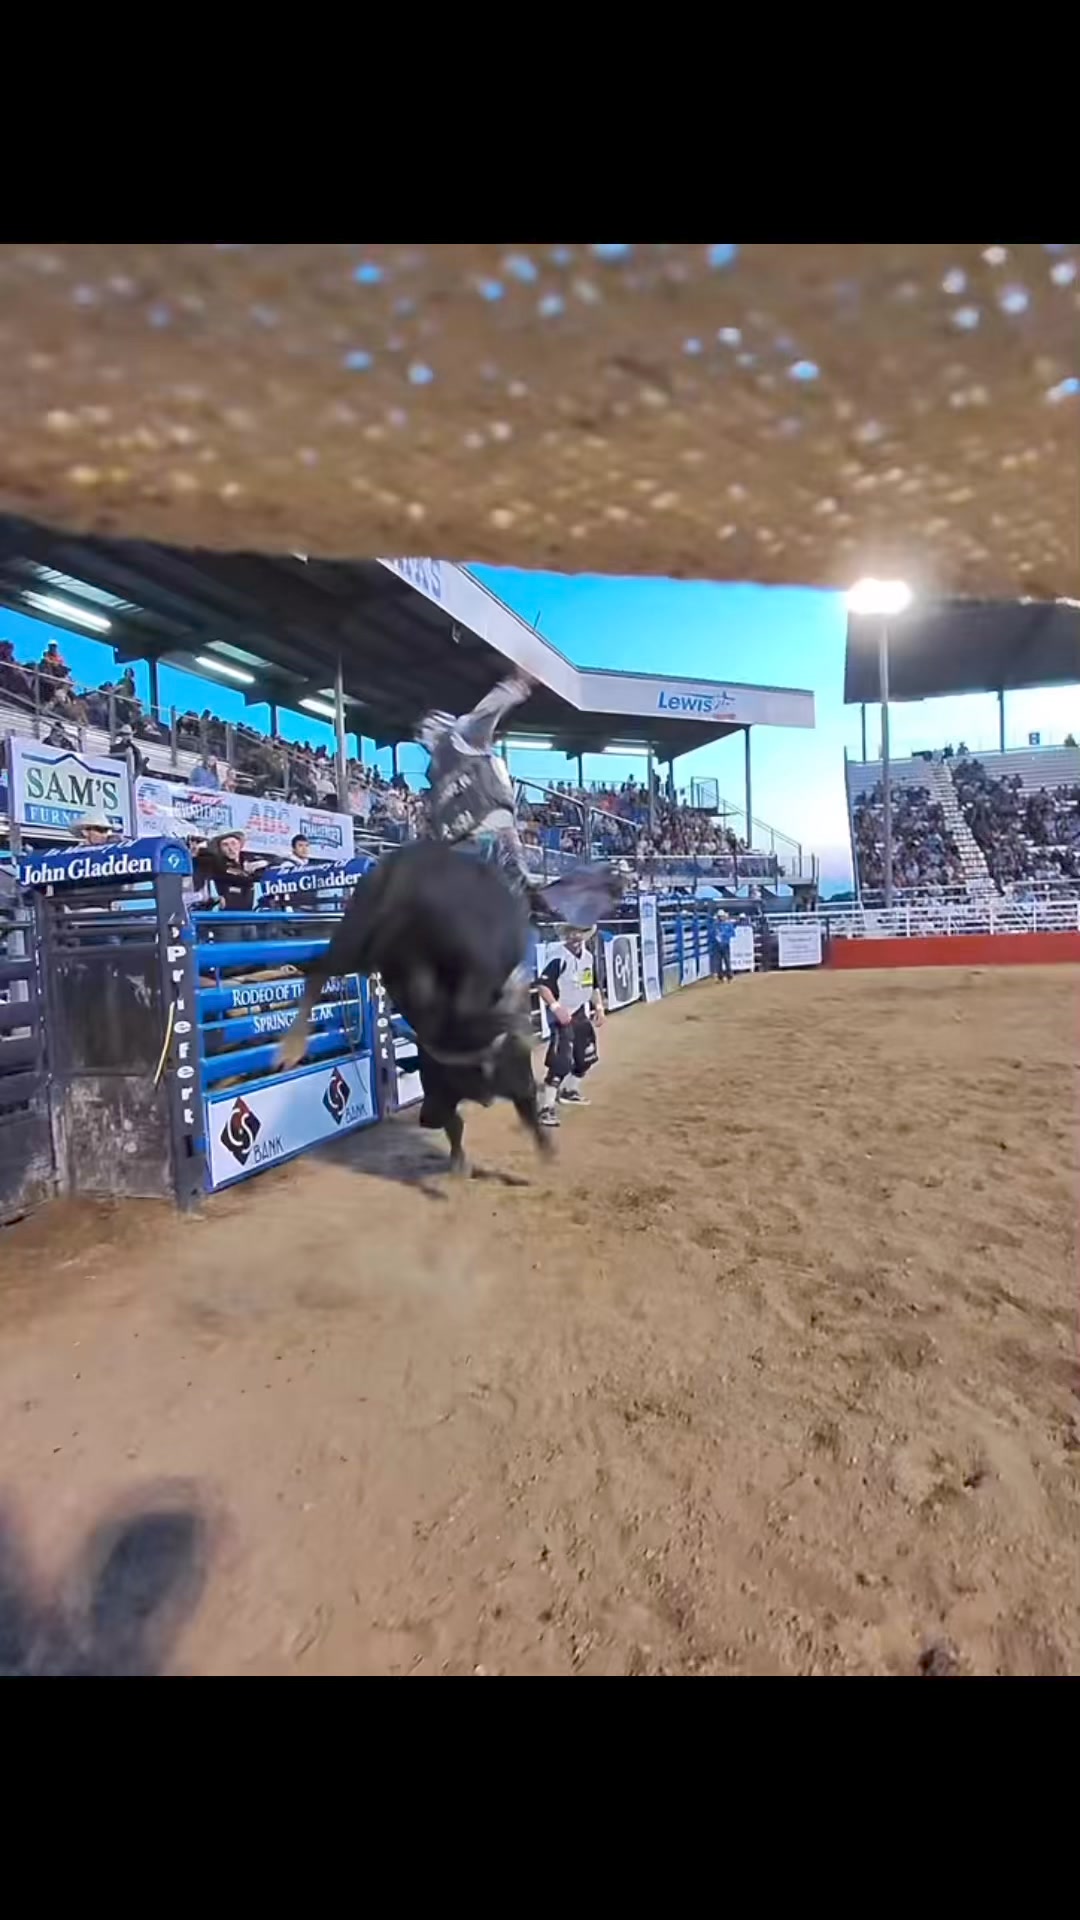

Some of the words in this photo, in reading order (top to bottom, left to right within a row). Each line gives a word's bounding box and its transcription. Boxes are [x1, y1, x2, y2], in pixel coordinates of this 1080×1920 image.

[658, 690, 713, 712] Lewis
[26, 767, 119, 810] SAM'S
[21, 863, 65, 886] John
[68, 854, 153, 880] Gladden
[263, 879, 298, 896] John
[232, 985, 274, 1007] RODEO
[275, 984, 290, 1001] OF
[290, 982, 305, 998] TH
[345, 1103, 369, 1124] BANK
[253, 1135, 284, 1164] BANK
